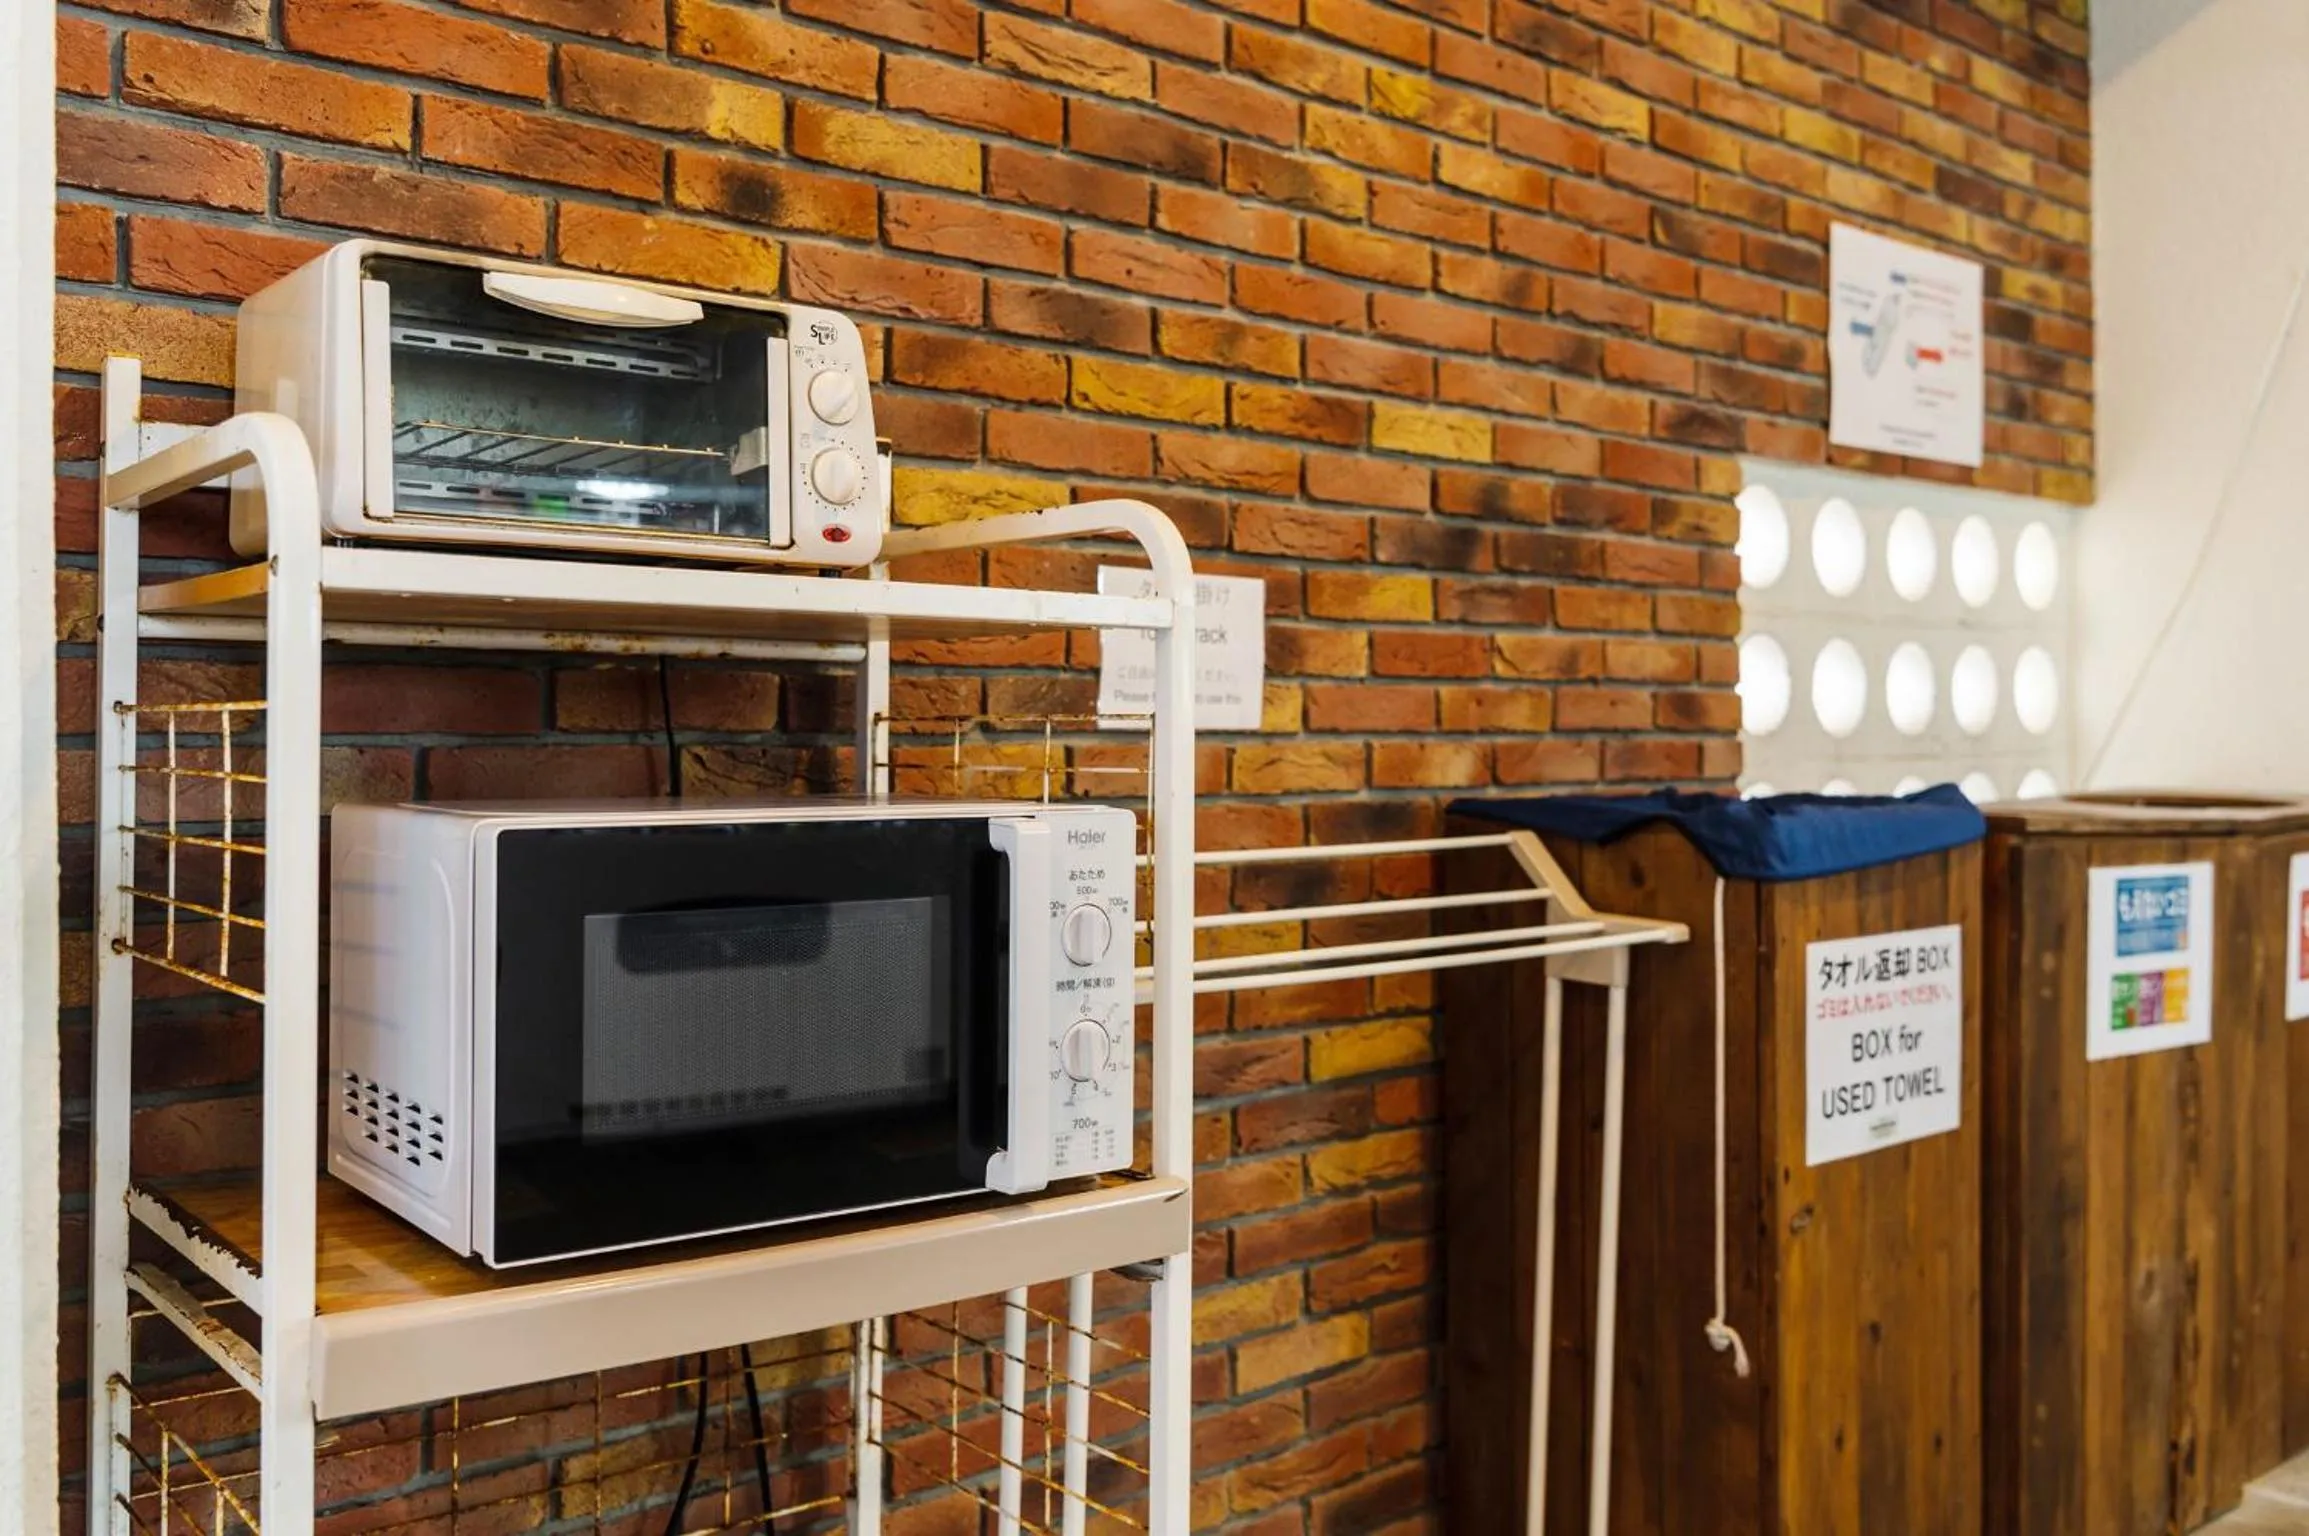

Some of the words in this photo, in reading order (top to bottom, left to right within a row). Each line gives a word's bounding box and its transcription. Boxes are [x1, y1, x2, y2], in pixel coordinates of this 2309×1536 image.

[1067, 829, 1106, 844] Haier
[1819, 948, 1911, 990] タオル返却
[1917, 946, 1953, 974] BOX
[1852, 1026, 1893, 1062] BOX
[1898, 1023, 1925, 1052] for
[1821, 1081, 1876, 1119] USED
[1882, 1066, 1945, 1102] TOWEL
